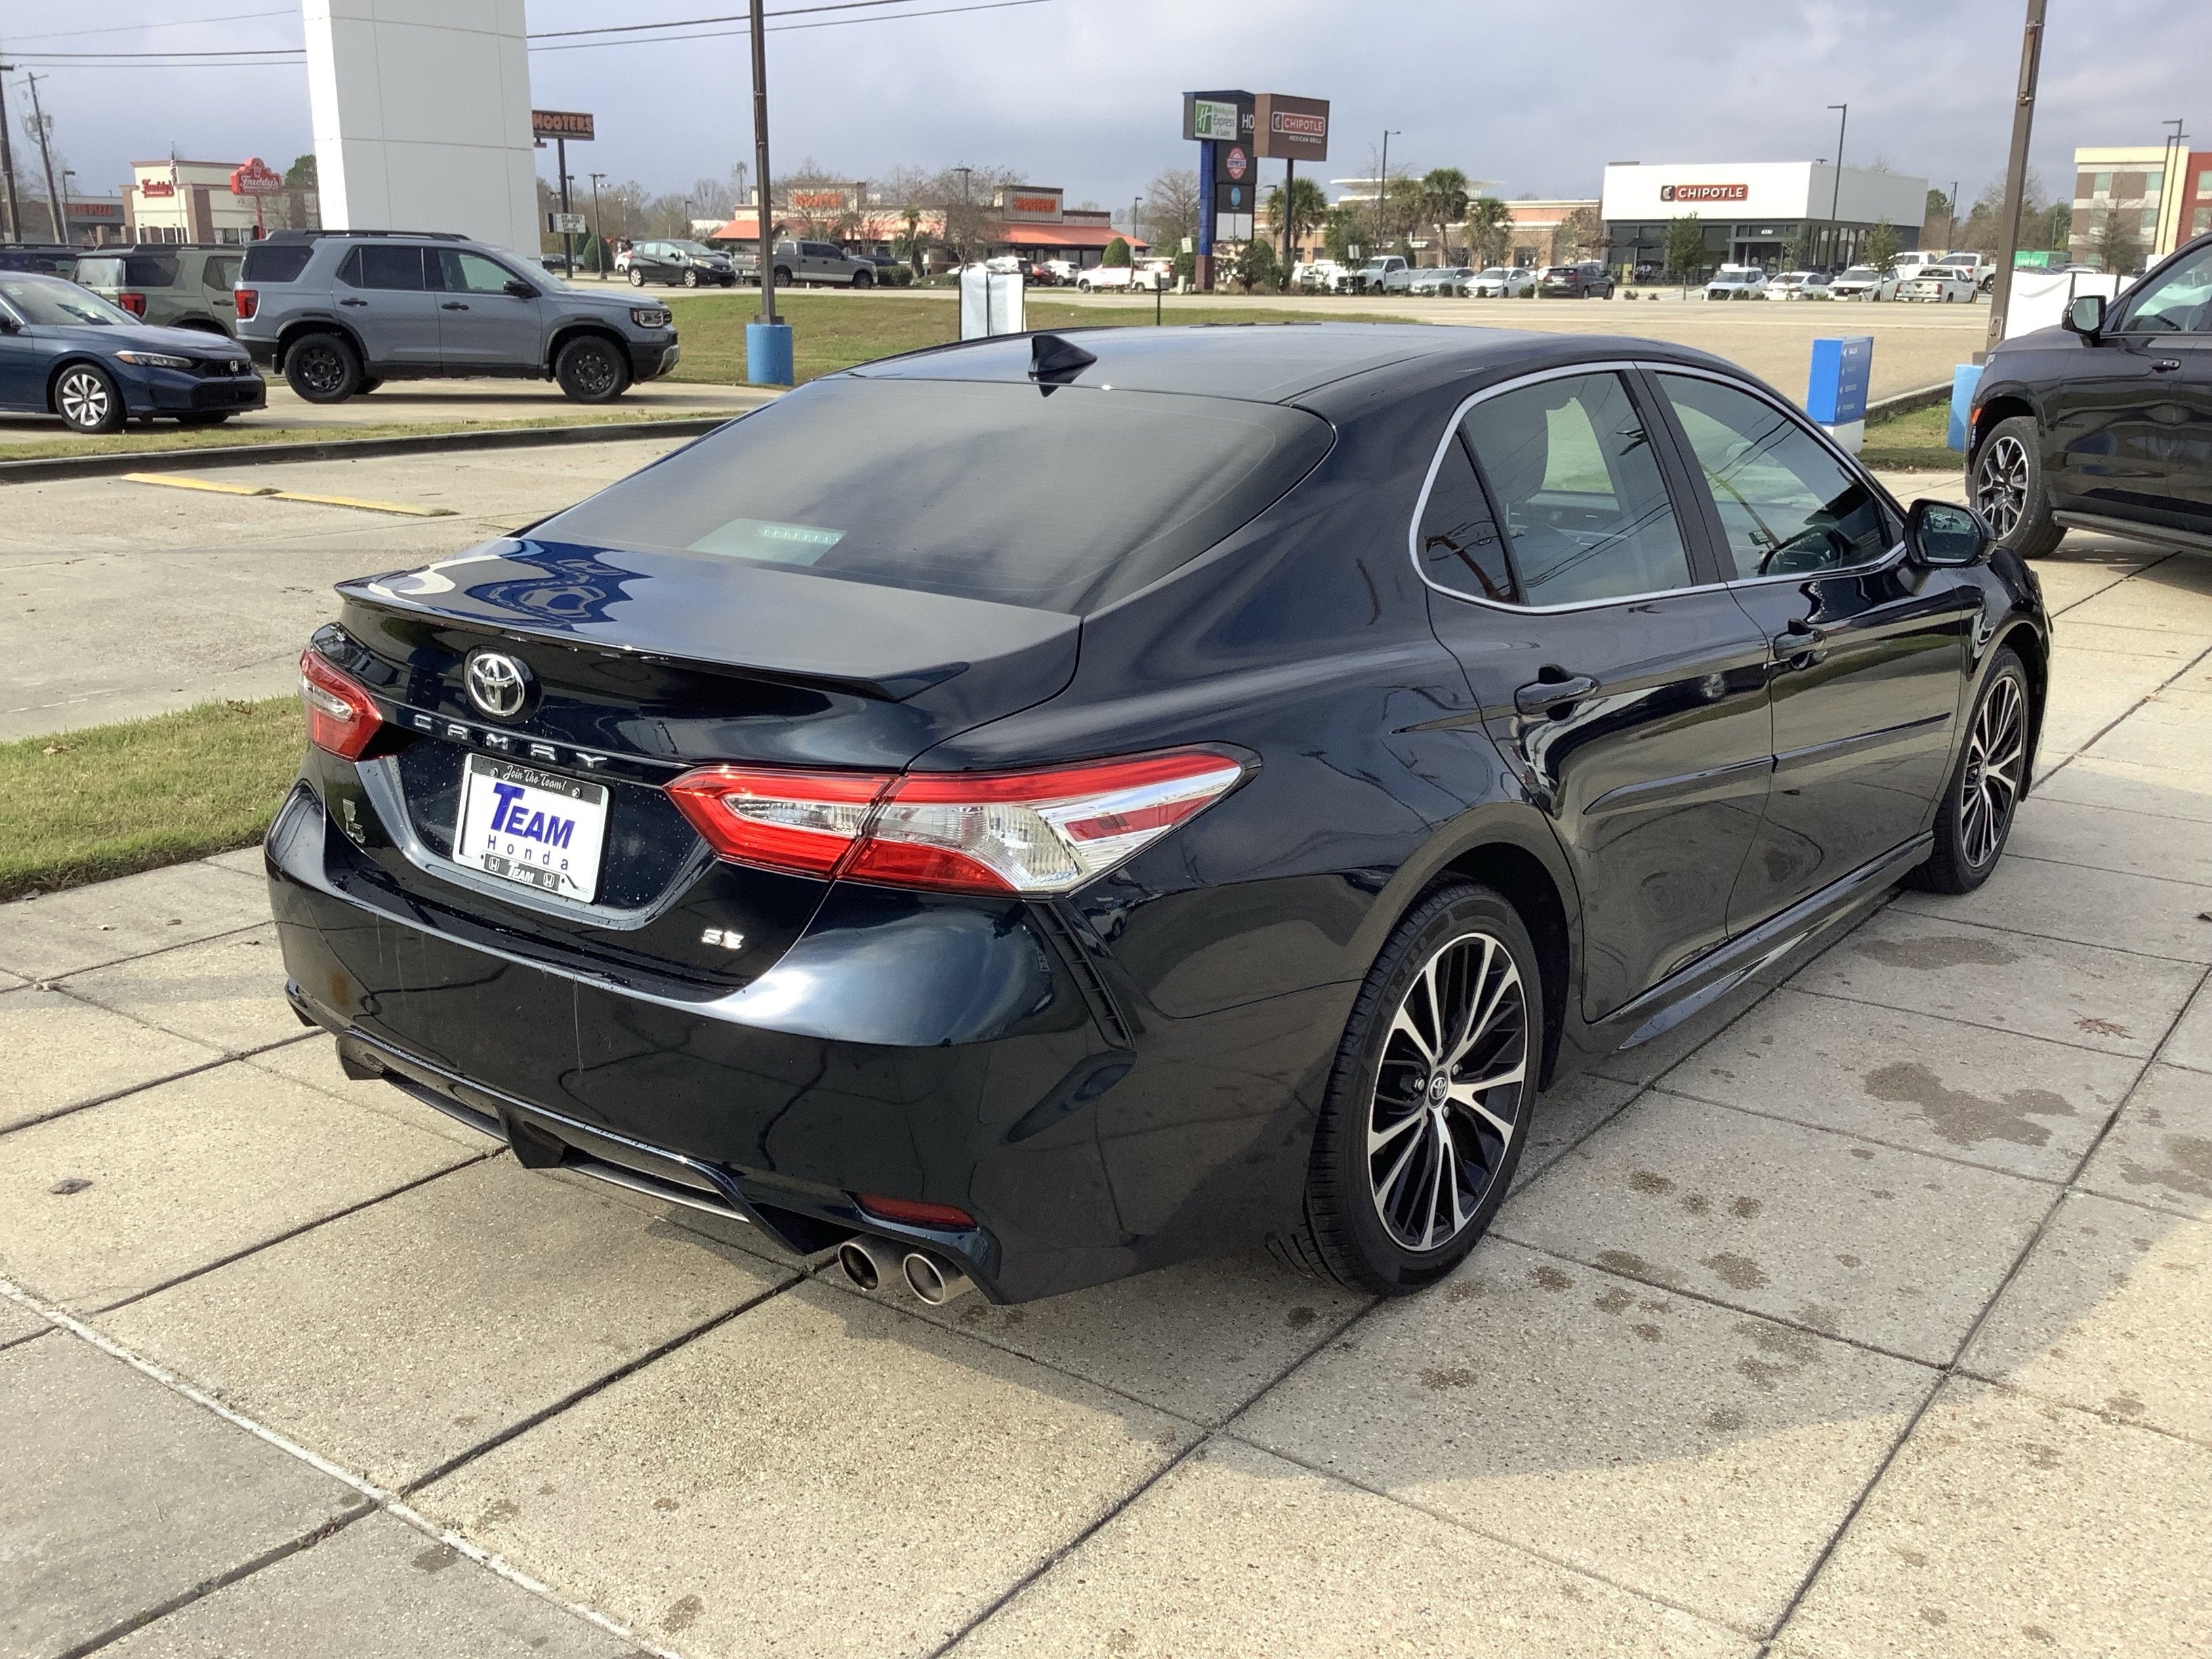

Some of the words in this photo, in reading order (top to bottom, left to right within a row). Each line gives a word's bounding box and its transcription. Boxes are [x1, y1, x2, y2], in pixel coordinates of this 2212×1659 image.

[533, 113, 593, 132] HOOTERS
[1213, 115, 1235, 127] Express
[1284, 118, 1323, 131] CHIPOTLE
[240, 175, 279, 189] Freddy's
[1678, 187, 1744, 198] CHIPOTLE
[89, 204, 114, 216] PIZZA
[413, 714, 608, 769] CAMRY
[503, 765, 523, 780] Join
[524, 769, 539, 783] The
[540, 773, 567, 791] Team!
[490, 782, 575, 850] TEAM
[487, 834, 569, 870] Honda
[508, 862, 535, 883] TEAM
[701, 929, 744, 949] SE
